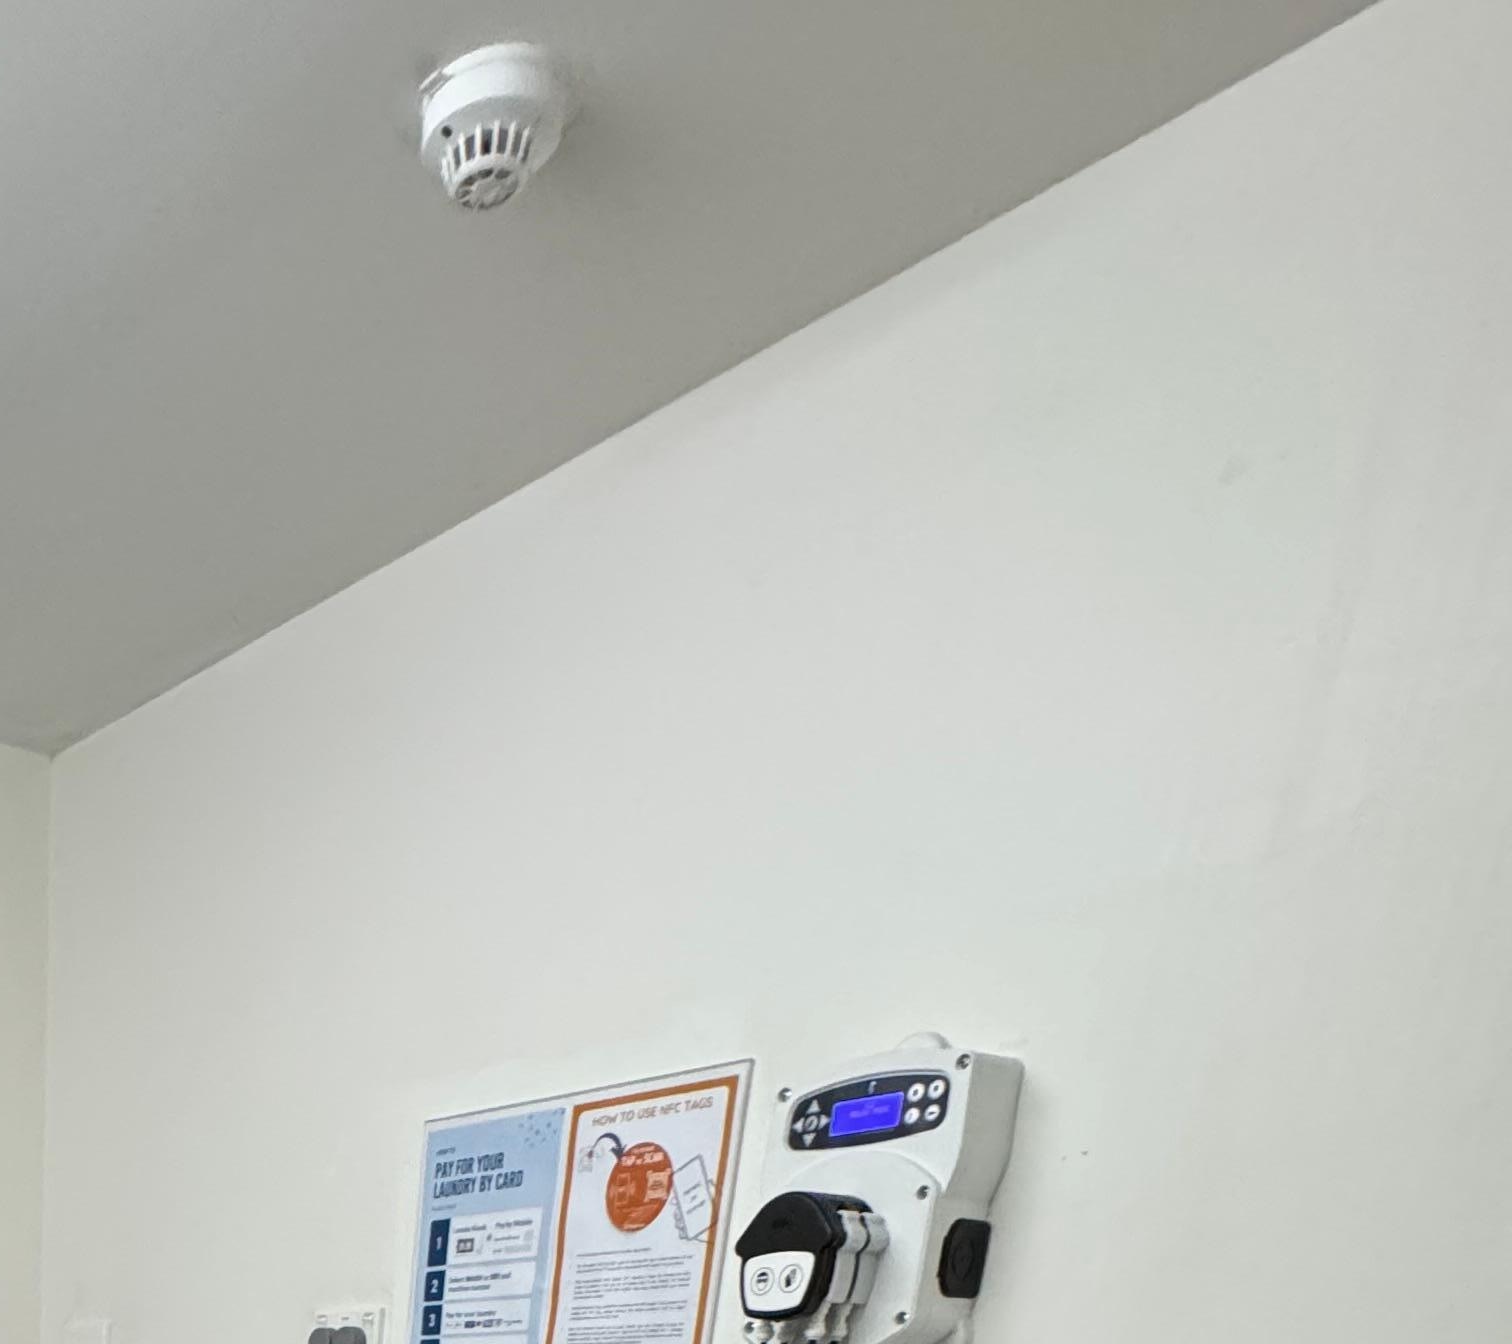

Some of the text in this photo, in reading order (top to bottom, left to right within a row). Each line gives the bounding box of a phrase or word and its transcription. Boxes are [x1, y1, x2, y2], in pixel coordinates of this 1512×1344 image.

[592, 1096, 713, 1126] HOW TO USE NFC TAGS
[435, 1152, 504, 1178] PAY FOR YOUR
[433, 1170, 523, 1198] LAUNDRY BY CARD
[436, 1236, 442, 1250] 1
[430, 1279, 439, 1293] 2
[428, 1314, 436, 1327] 3
